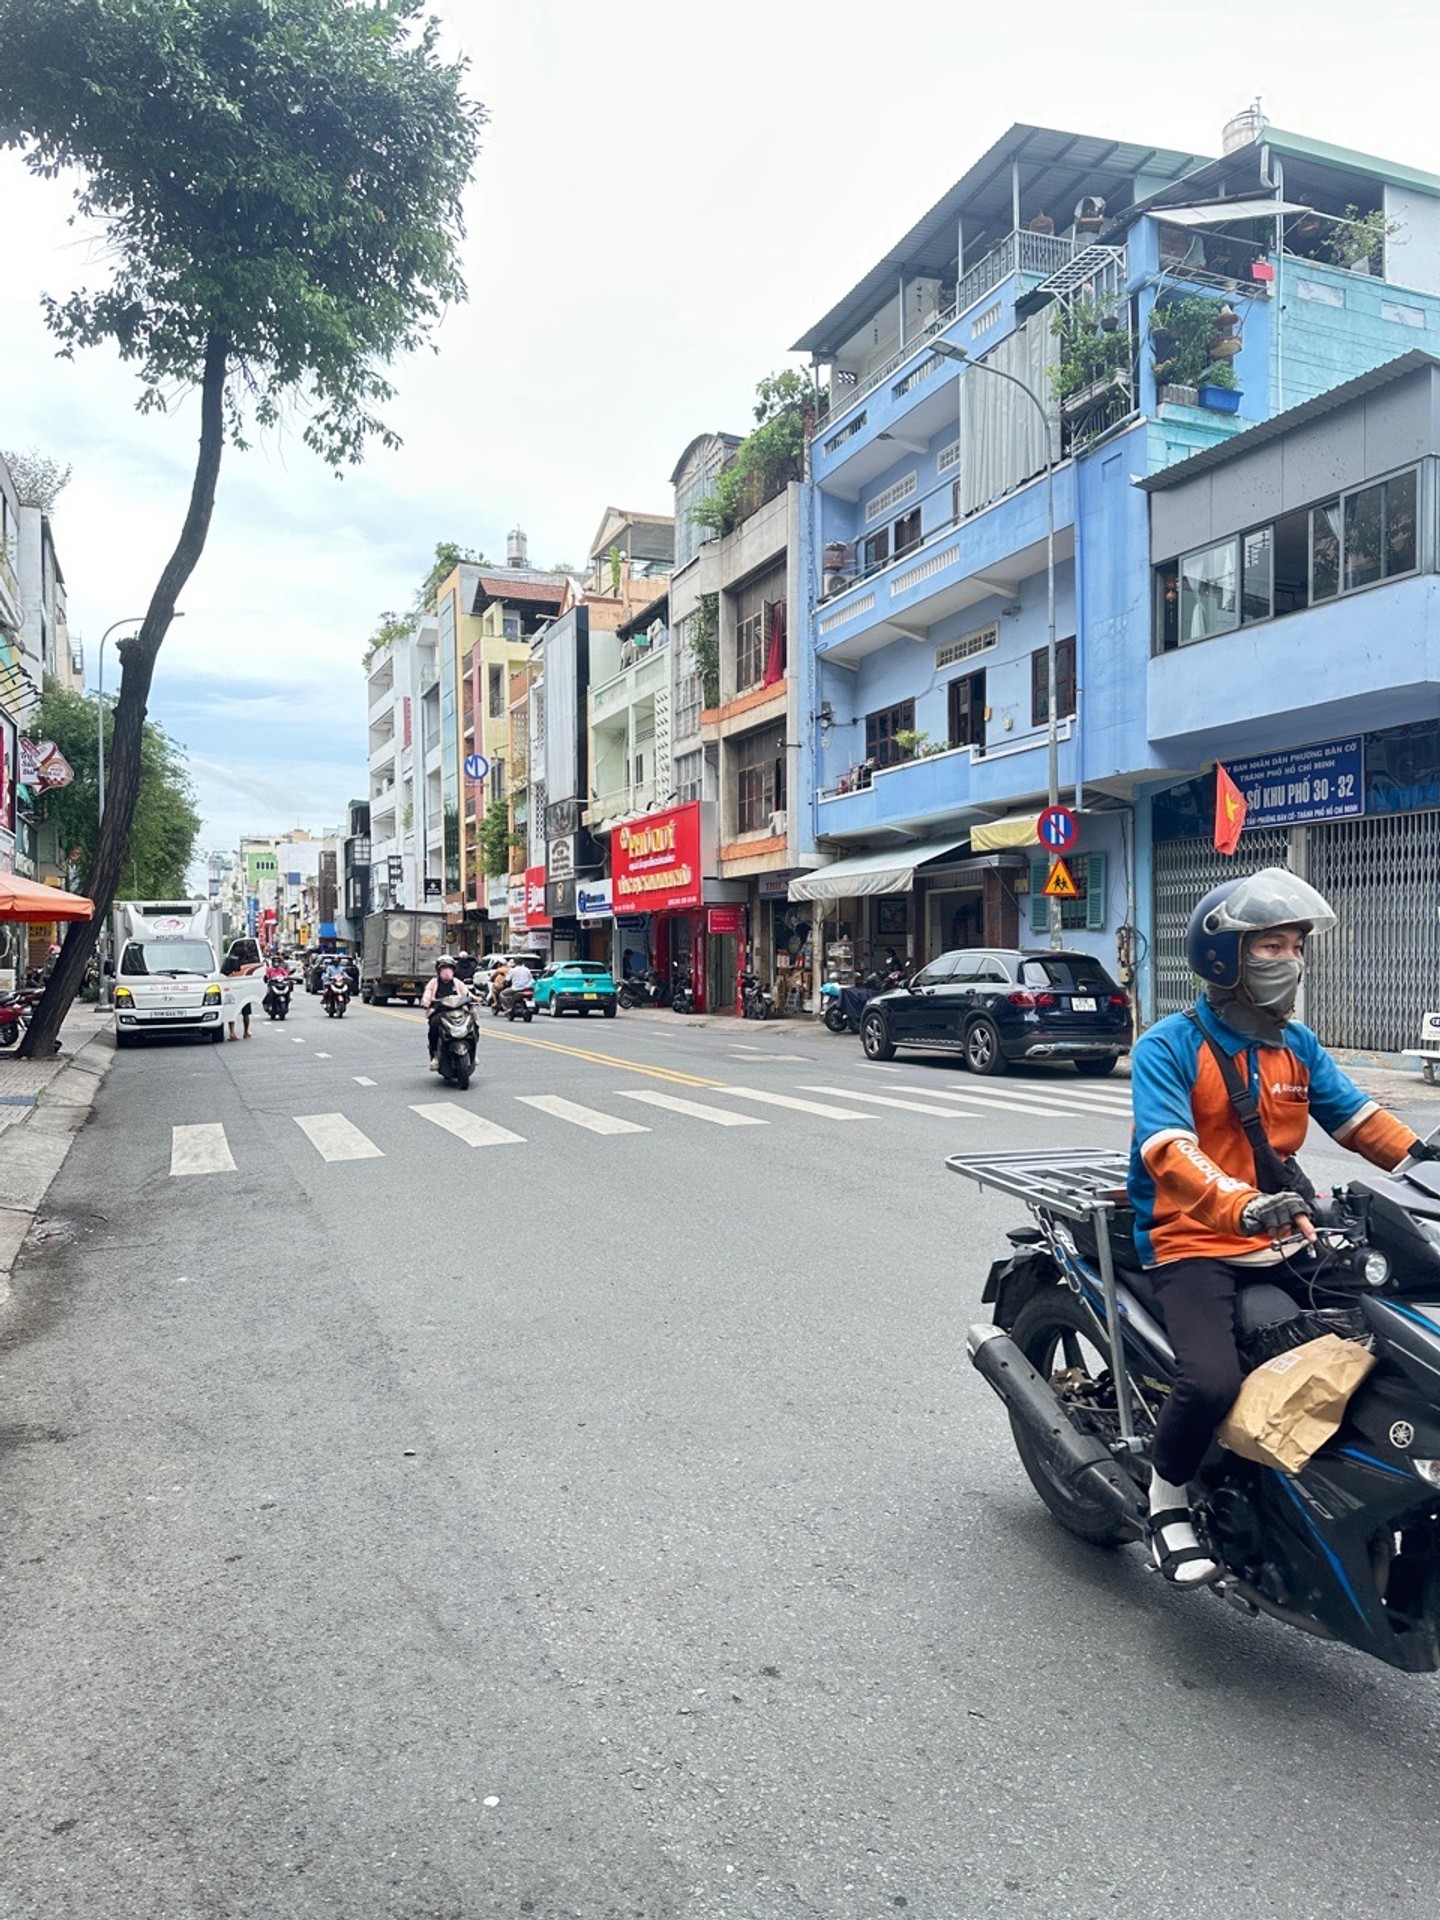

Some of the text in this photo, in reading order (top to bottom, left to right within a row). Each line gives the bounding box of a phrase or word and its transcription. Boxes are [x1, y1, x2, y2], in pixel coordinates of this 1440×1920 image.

[1233, 763, 1248, 773] BAN
[1249, 758, 1270, 769] NHÂN
[1272, 755, 1288, 765] DÂN
[1324, 745, 1343, 756] BÀN
[1344, 741, 1357, 752] CỜ
[1240, 759, 1335, 783] THÀNH PHỐ HỒ CHÍ MINH
[1247, 783, 1261, 810] SỞ
[1263, 785, 1285, 808] KHU
[1288, 774, 1311, 805] PHỐ
[1313, 778, 1329, 801] 30
[1337, 774, 1354, 798] 32
